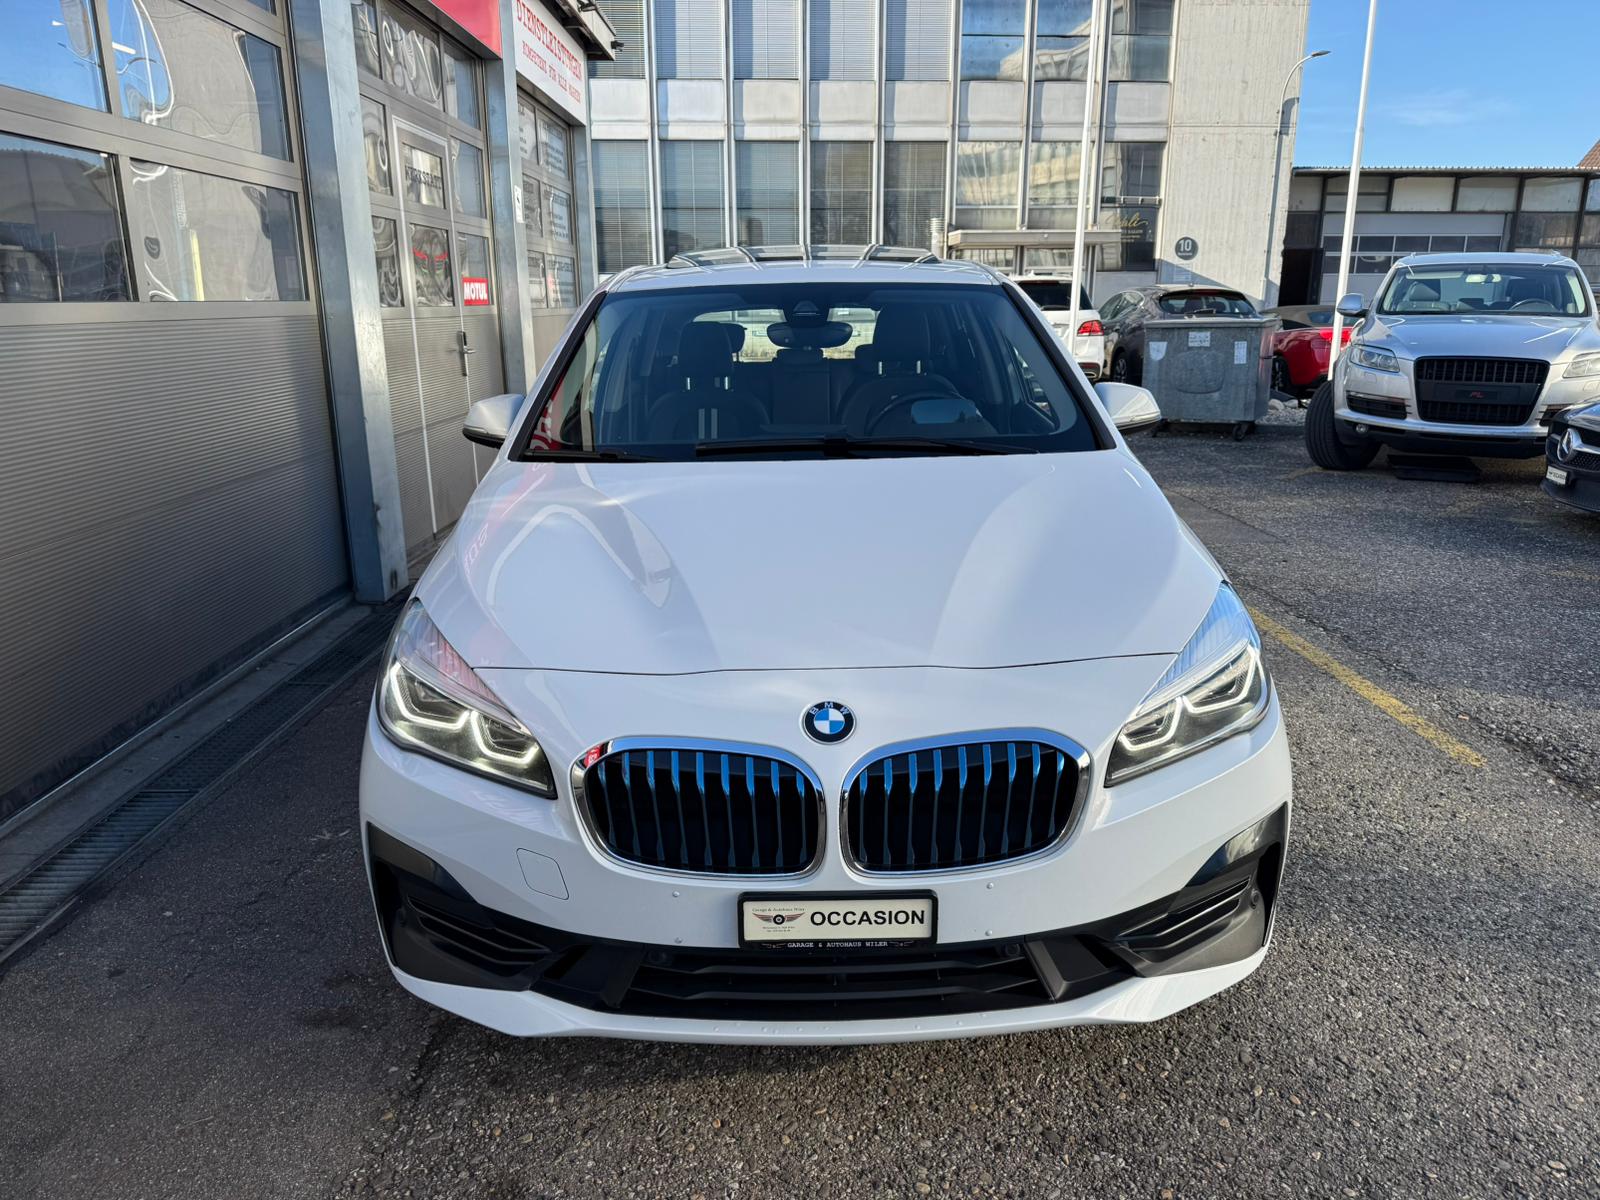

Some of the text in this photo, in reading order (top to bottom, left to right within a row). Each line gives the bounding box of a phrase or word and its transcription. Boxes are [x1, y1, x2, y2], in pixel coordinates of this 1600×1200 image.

[1179, 239, 1192, 252] 10
[464, 282, 488, 302] MOTUL
[809, 702, 850, 715] BMW
[810, 909, 925, 926] OCCASION
